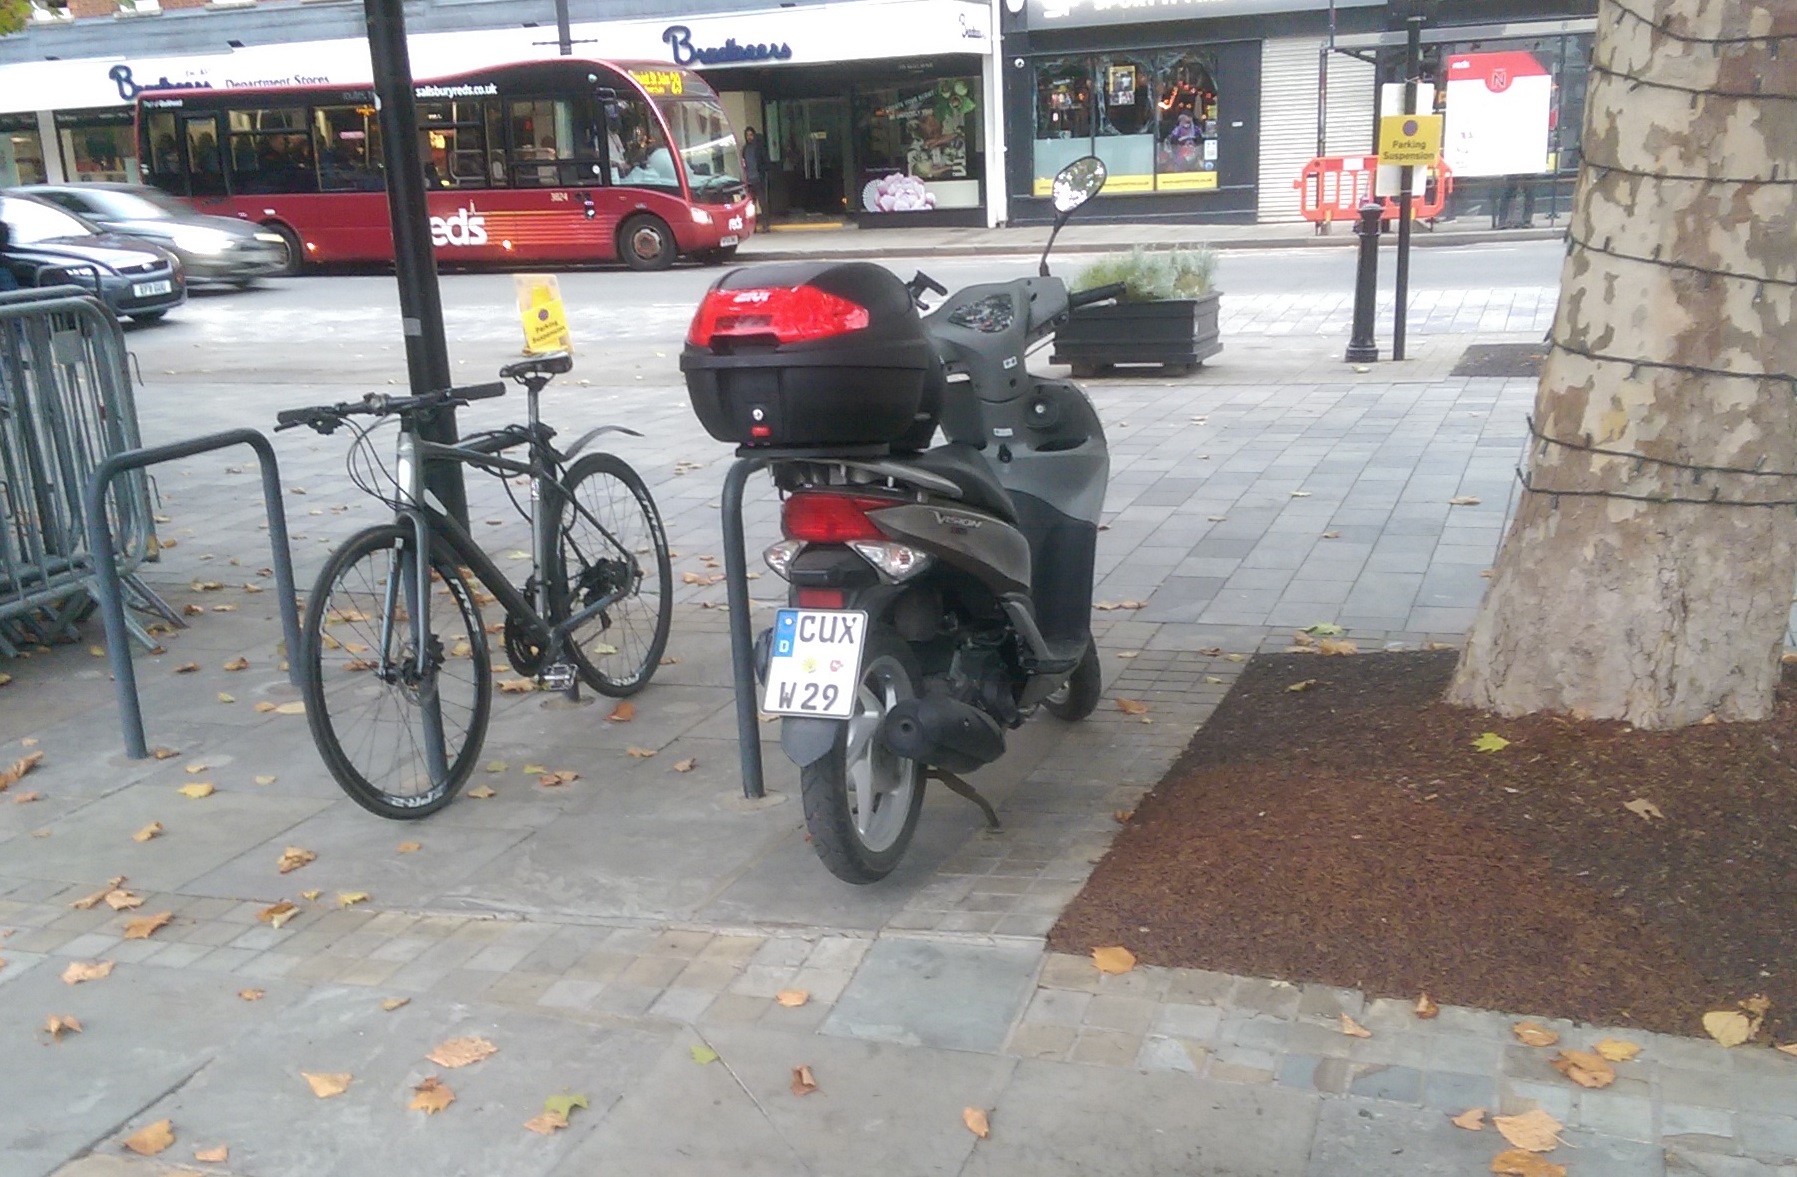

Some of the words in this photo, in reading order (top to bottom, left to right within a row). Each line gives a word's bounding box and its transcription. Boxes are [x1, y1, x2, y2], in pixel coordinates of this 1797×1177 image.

[294, 74, 330, 86] Stores
[415, 83, 498, 98] salisburyreds.co.uk
[1392, 140, 1426, 150] Parking
[1383, 151, 1435, 161] Suspension
[429, 208, 488, 246] eds
[799, 615, 858, 644] CUX
[778, 640, 790, 653] D
[779, 682, 797, 709] W
[800, 682, 840, 711] 29
